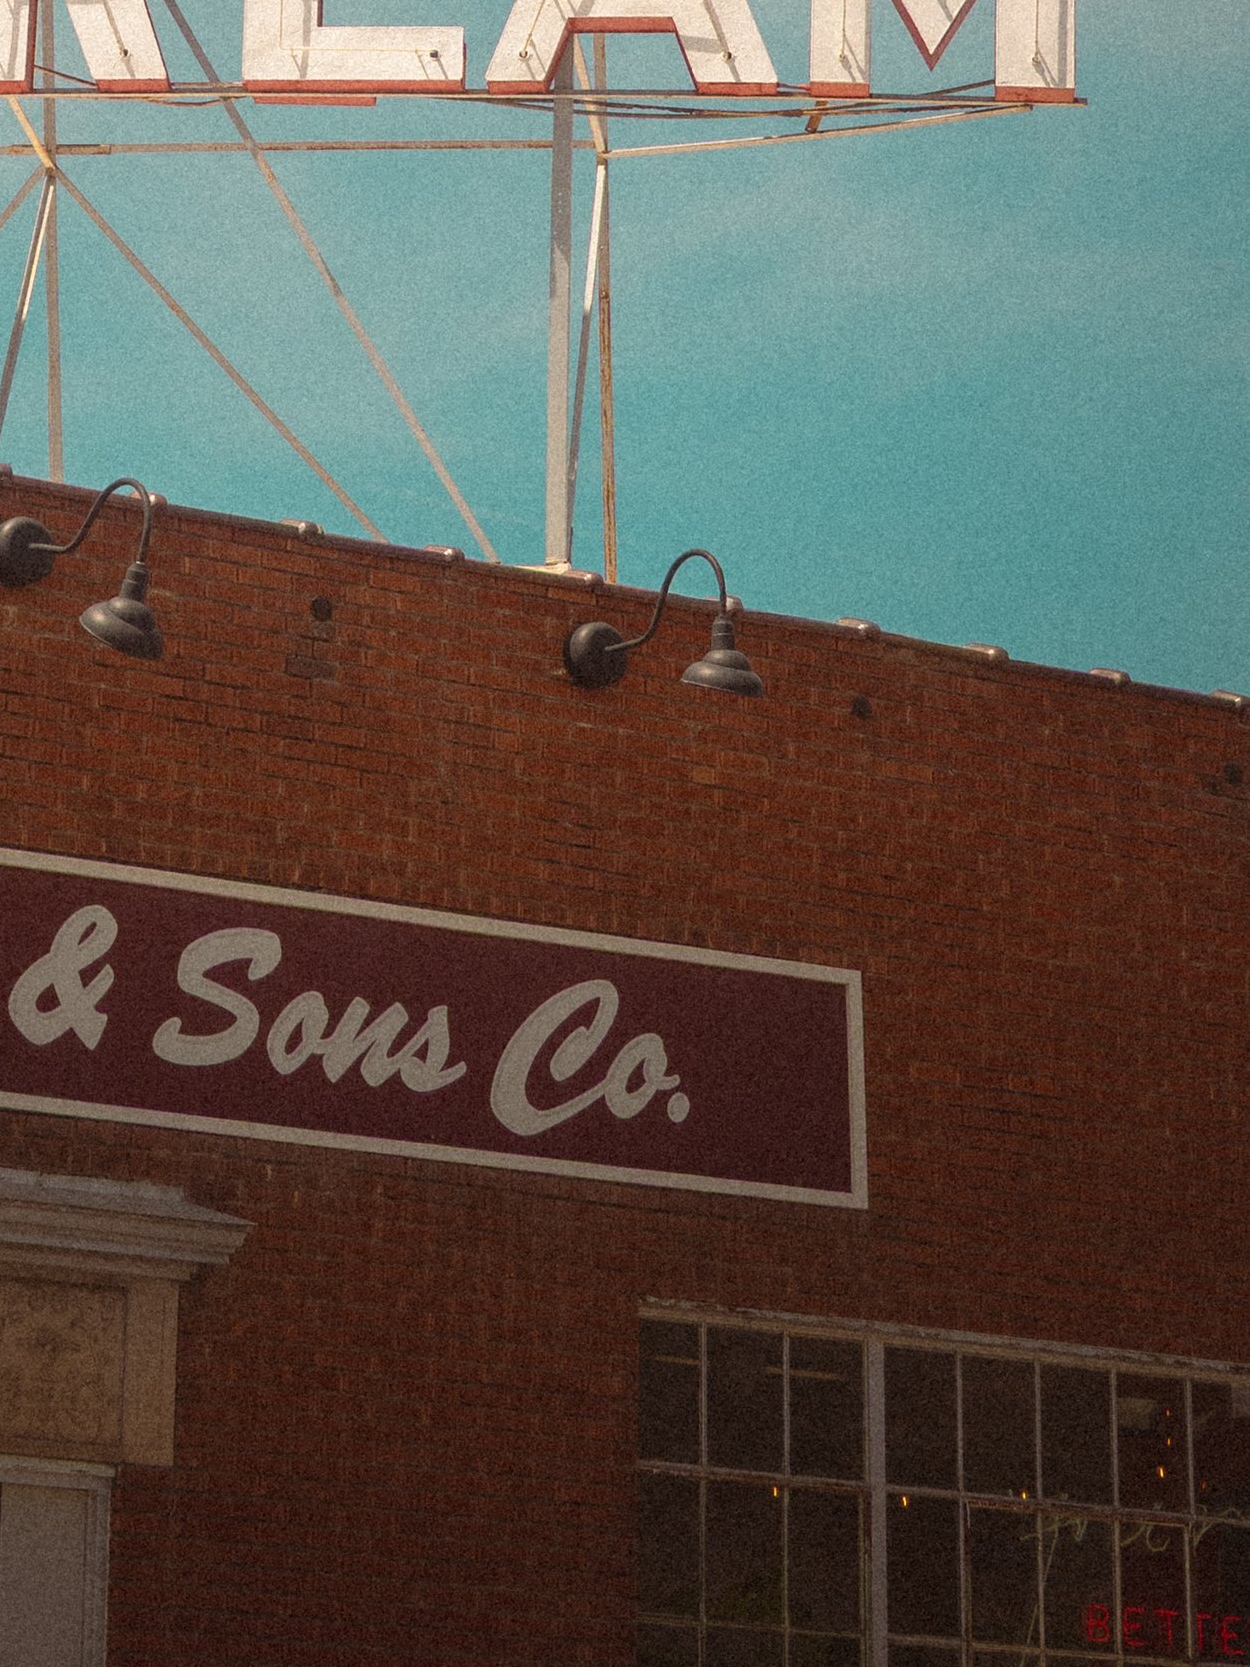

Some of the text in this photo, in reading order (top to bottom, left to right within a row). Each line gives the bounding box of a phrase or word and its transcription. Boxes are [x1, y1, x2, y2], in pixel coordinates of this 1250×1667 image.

[7, 904, 119, 1051] &
[151, 926, 468, 1093] Sons
[490, 978, 691, 1137] Co.
[1085, 1602, 1250, 1656] BETTE
